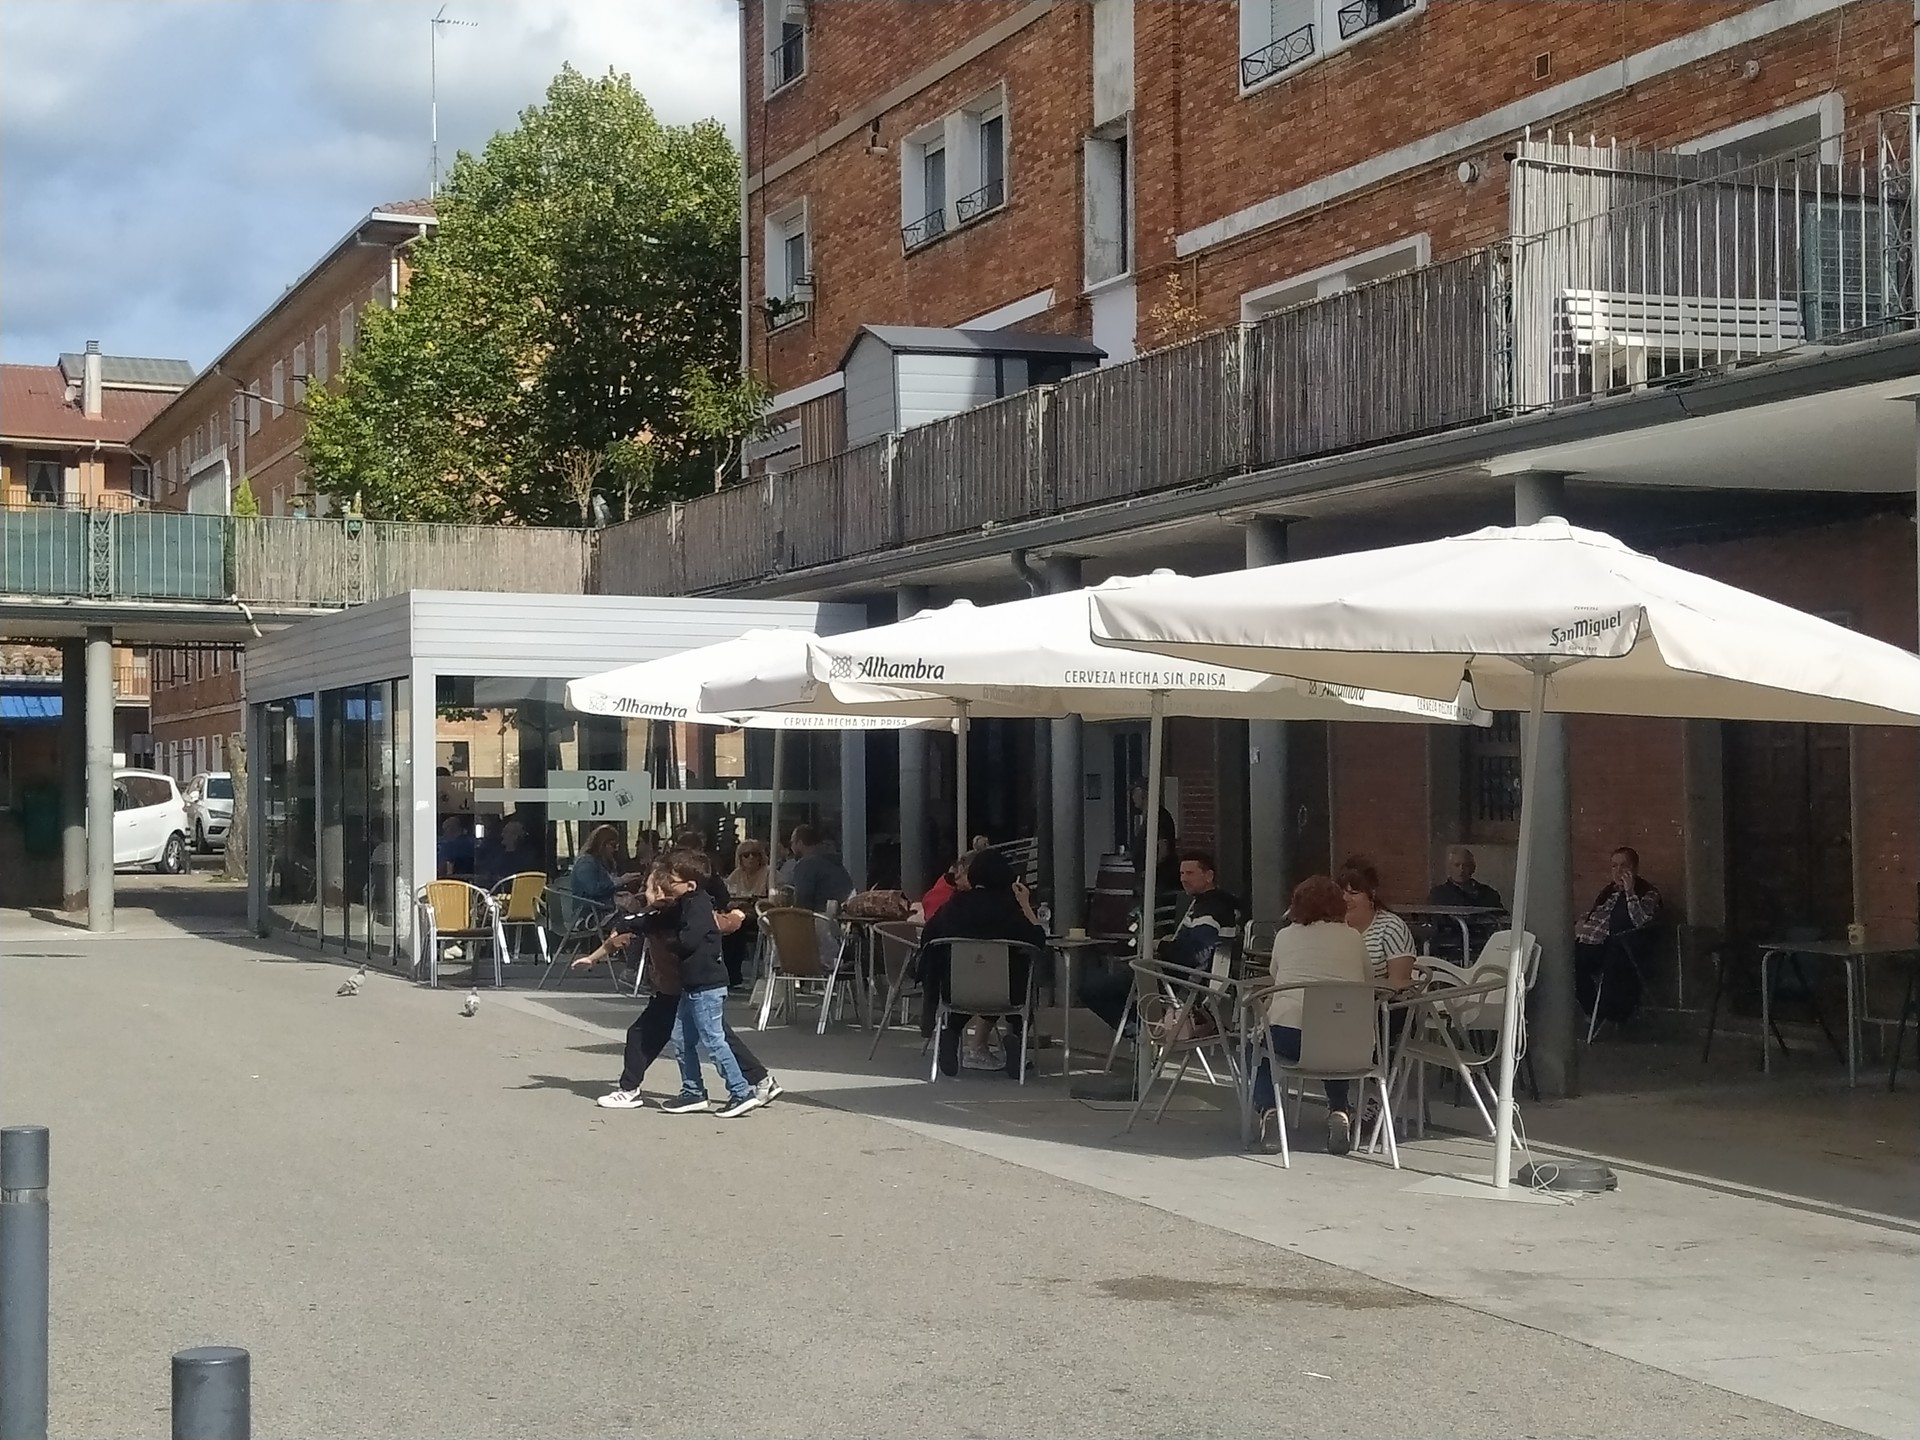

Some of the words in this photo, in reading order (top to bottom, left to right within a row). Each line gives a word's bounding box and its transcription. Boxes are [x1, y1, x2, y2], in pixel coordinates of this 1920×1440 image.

[855, 656, 945, 680] Alhambra
[1064, 670, 1116, 684] CERVEZA
[1119, 671, 1159, 685] HECHA
[1163, 672, 1184, 685] SIN
[1189, 672, 1227, 686] PRISA
[612, 697, 688, 719] Alhambra
[783, 717, 824, 727] CERVEZA
[827, 718, 858, 727] HECHA
[861, 718, 877, 727] SIN
[880, 718, 908, 727] PRISA
[586, 775, 615, 791] Bar
[591, 800, 605, 816] JJ
